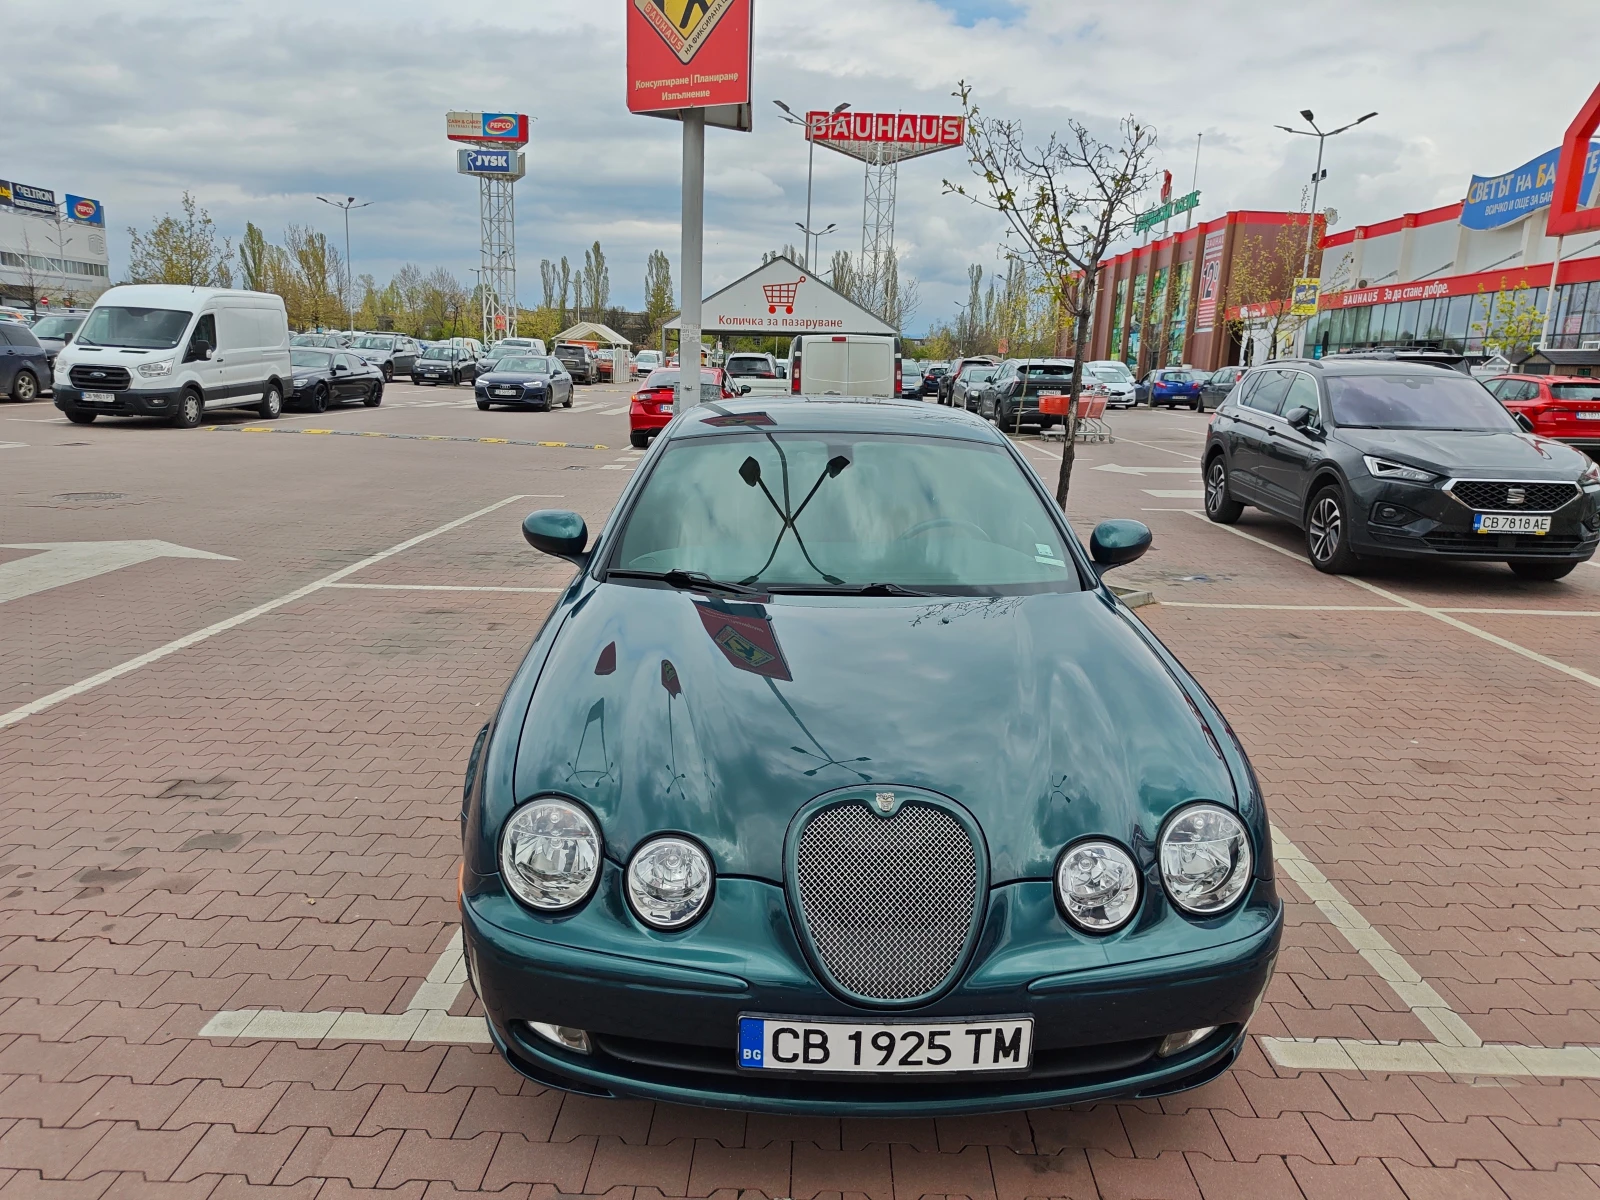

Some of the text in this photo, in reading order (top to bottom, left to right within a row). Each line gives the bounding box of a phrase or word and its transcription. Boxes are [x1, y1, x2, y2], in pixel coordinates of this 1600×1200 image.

[644, 3, 683, 51] BAUHAUS
[684, 3, 723, 55] НА ФИКСИРАНА
[661, 90, 710, 101] Изпълнение
[811, 115, 959, 140] BAUHAUS
[476, 155, 508, 167] JYSK
[1467, 173, 1515, 204] СВЕТЪТ
[1515, 173, 1532, 192] НА
[77, 205, 94, 214] PEPCO
[1485, 202, 1509, 216] ВСИЧКО
[1514, 197, 1529, 211] ОЩЕ
[1530, 194, 1539, 206] ЗА
[1539, 190, 1553, 204] БАН
[1343, 290, 1379, 305] BAUHAUS
[1384, 281, 1449, 301] За да стане добре.
[718, 315, 843, 329] Количка за пазаруване
[1482, 516, 1549, 530] CB 7818 AE
[742, 1048, 762, 1061] BG
[772, 1027, 1023, 1066] CB 1925 TM
